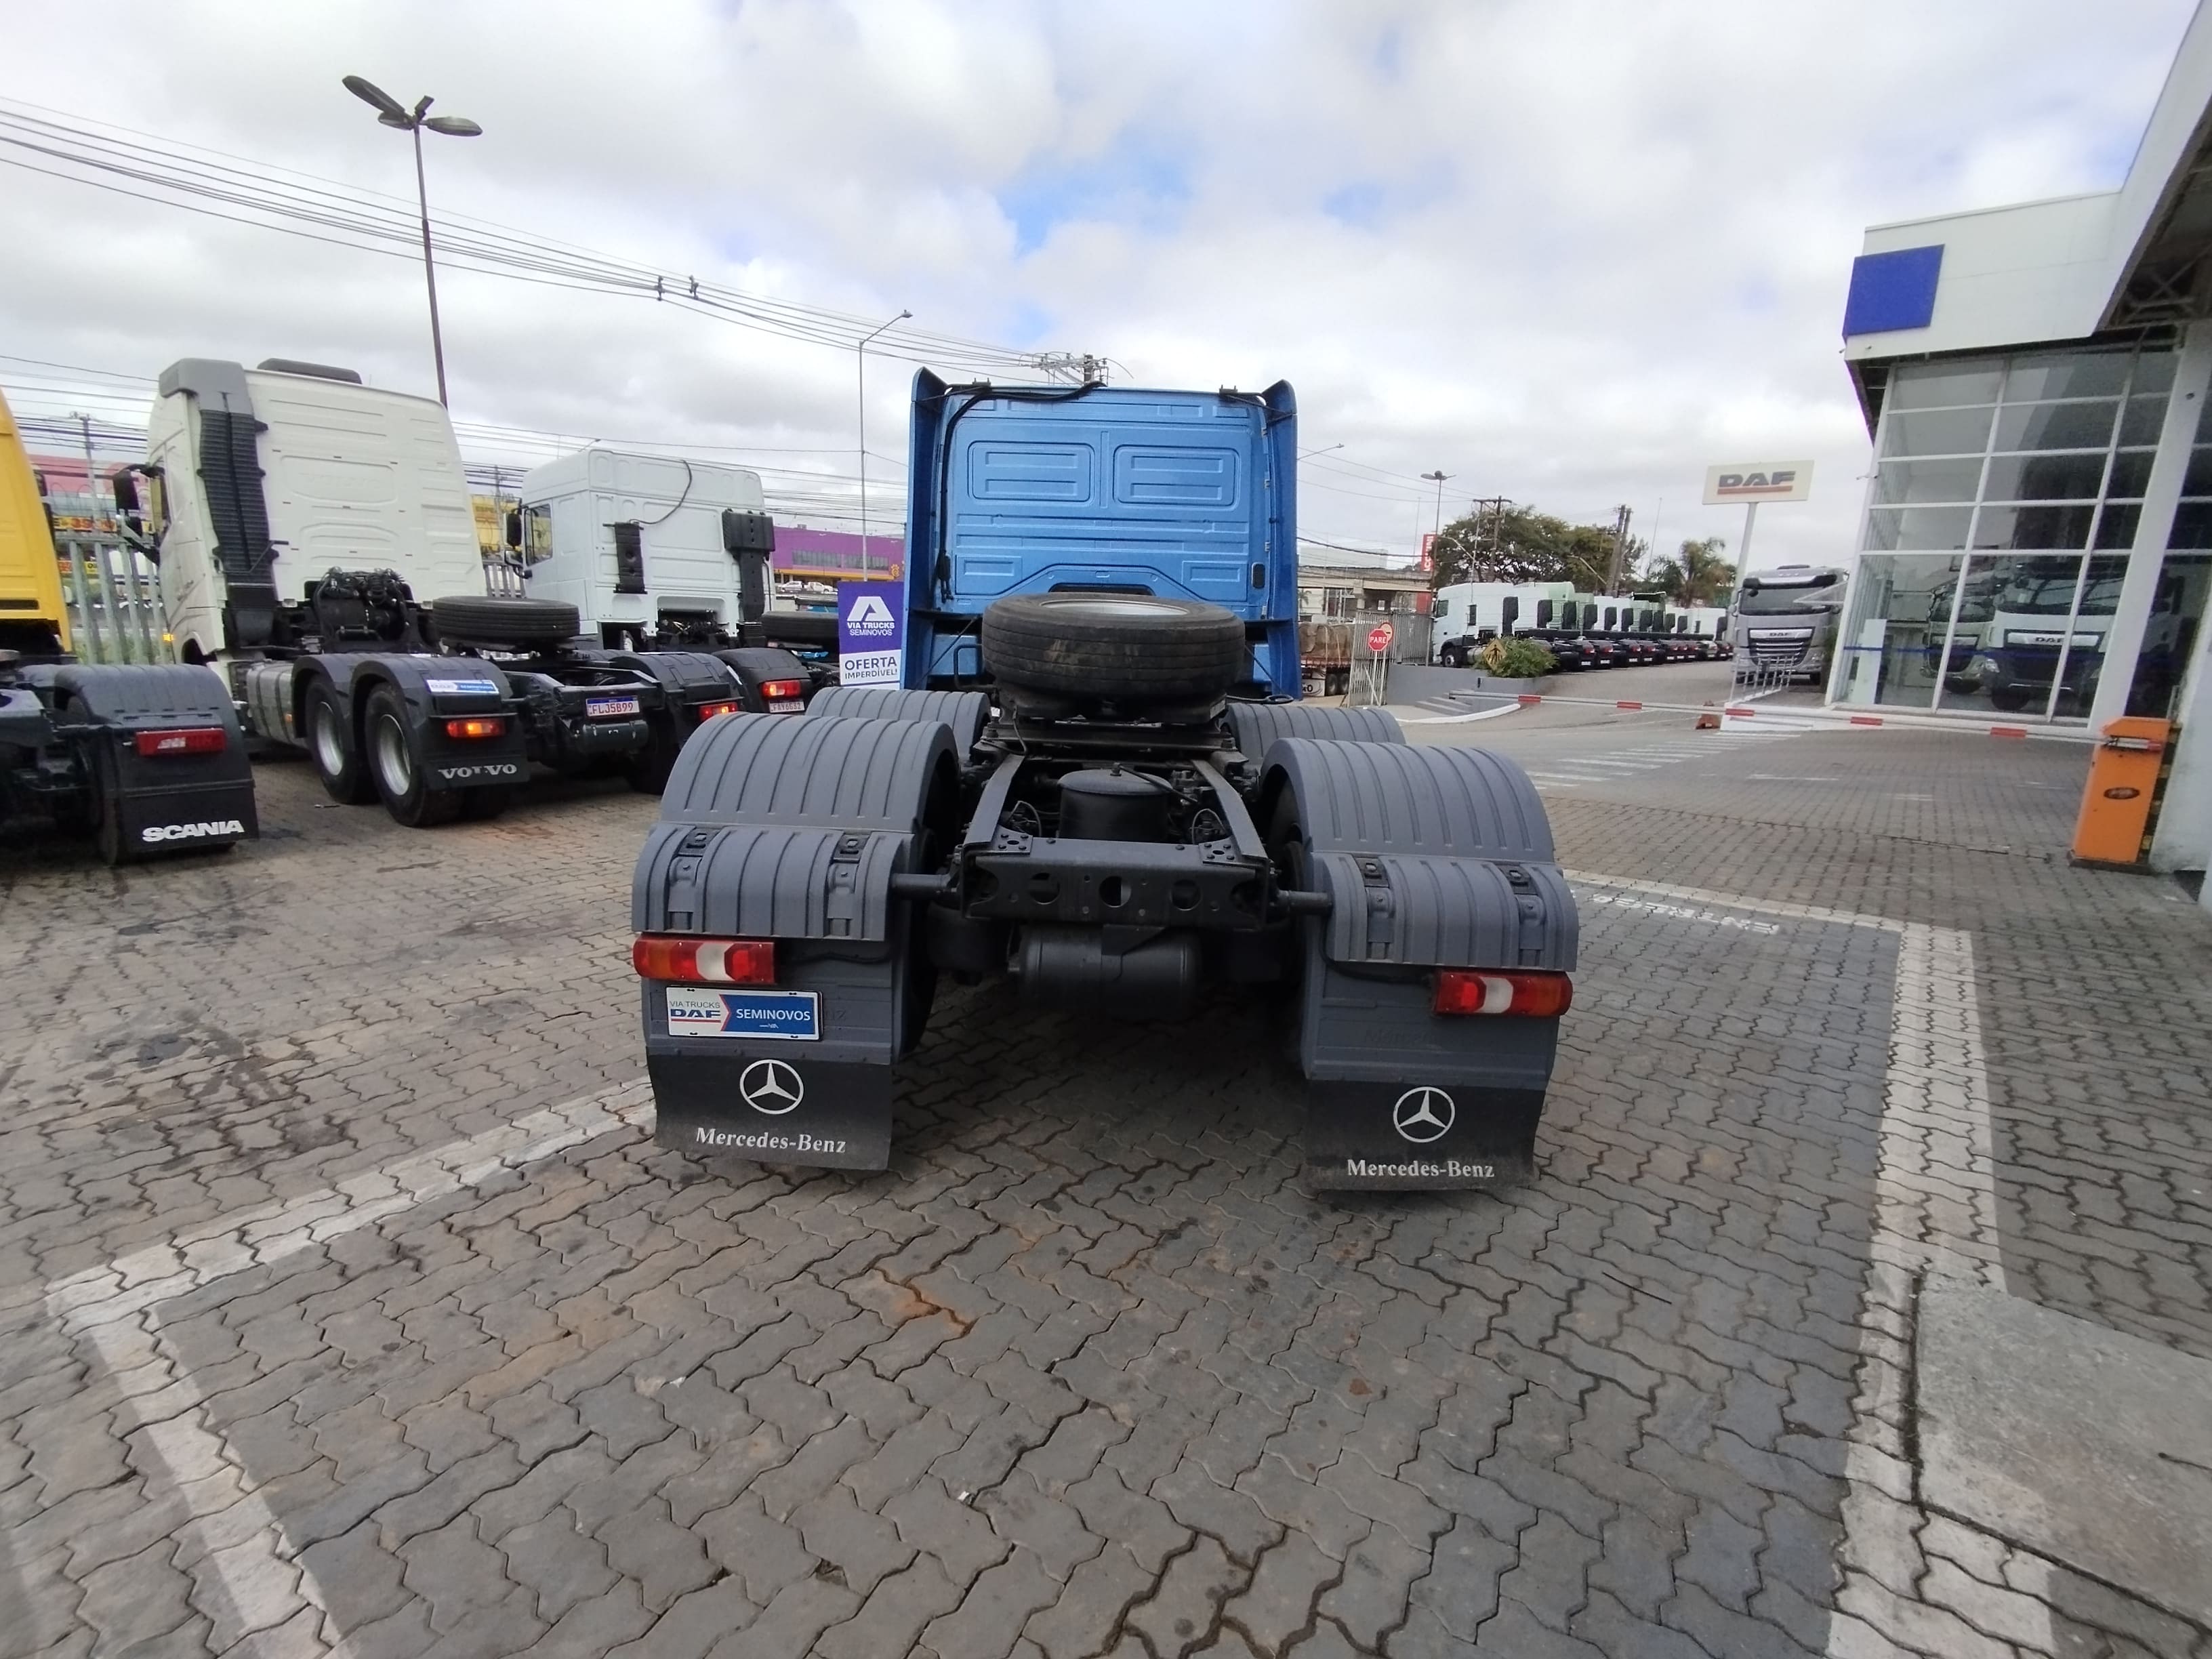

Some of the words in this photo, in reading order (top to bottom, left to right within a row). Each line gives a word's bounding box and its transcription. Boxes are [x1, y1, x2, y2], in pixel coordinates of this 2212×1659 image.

[1718, 471, 1796, 487] DAF
[844, 657, 897, 670] OFERTA
[845, 668, 898, 679] IMPERDÍVEL!
[142, 820, 245, 842] SCANIA
[670, 1008, 721, 1018] DAF
[736, 1008, 811, 1021] SEMINOVOS
[696, 1127, 846, 1153] Mercedes-Benz
[1347, 1159, 1495, 1178] Mercedes-Benz
